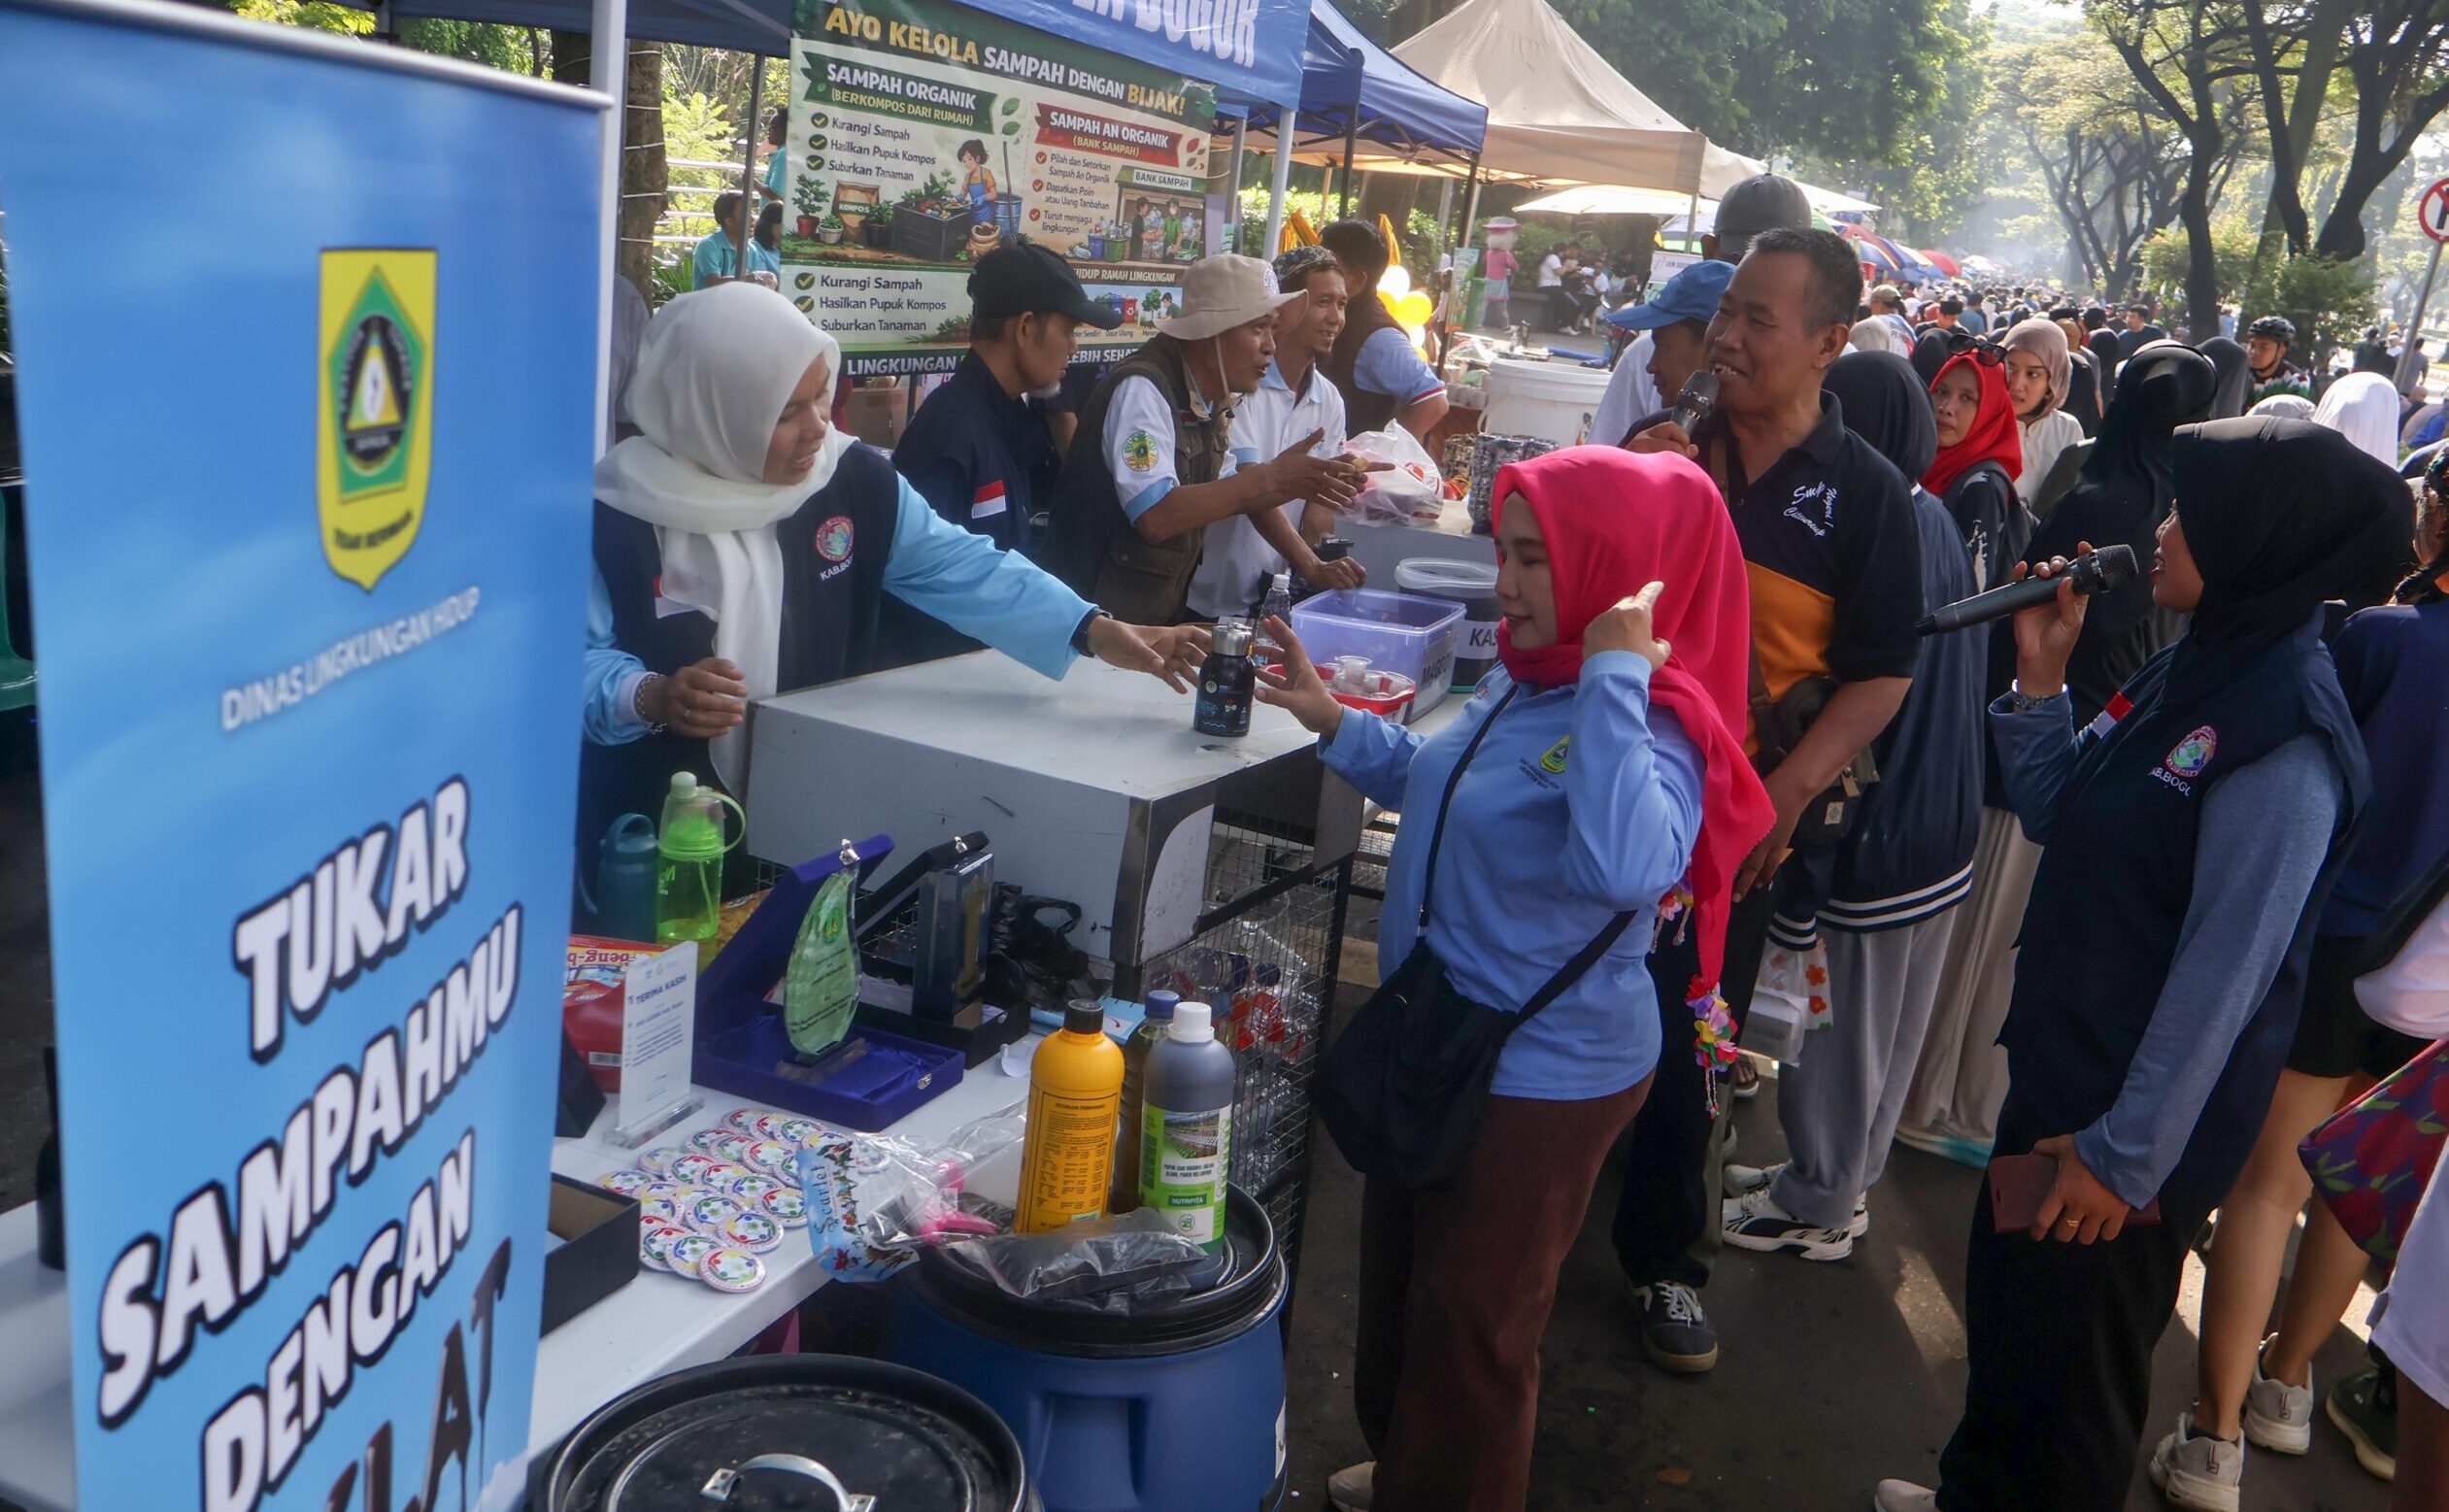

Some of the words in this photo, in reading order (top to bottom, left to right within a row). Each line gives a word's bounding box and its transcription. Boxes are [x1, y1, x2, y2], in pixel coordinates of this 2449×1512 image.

[825, 7, 881, 41] AYO
[889, 21, 979, 65] KELOLA
[984, 47, 1065, 84] SAMPAH
[1068, 69, 1124, 99] DENGAN
[1127, 84, 1187, 116] BIJAK!
[826, 63, 902, 95] SAMPAH
[906, 81, 977, 110] ORGANIK
[831, 87, 905, 114] (BERKOMPOS
[907, 104, 932, 118] DARI
[933, 109, 974, 127] RUMAH)
[831, 117, 871, 137] Kurangi
[873, 124, 910, 142] Sampah
[1050, 112, 1101, 136] SAMPAH
[1102, 122, 1119, 139] AN
[1121, 127, 1169, 149] ORGANIK
[830, 139, 870, 156] Hasilkan
[872, 147, 899, 161] Pupuk
[902, 151, 936, 166] Kompos
[1073, 135, 1101, 151] (BANK
[1102, 139, 1140, 157] SAMPAH)
[828, 160, 872, 177] Suburkan
[876, 166, 914, 182] Tanaman
[1050, 153, 1068, 165] Pilah
[1068, 157, 1082, 166] dan
[1082, 159, 1111, 172] Setorkan
[1049, 166, 1075, 179] Sampah
[1076, 170, 1085, 180] An
[1085, 173, 1110, 185] Organik
[1135, 172, 1156, 185] BANK
[1157, 174, 1190, 188] SAMPAH
[1046, 182, 1078, 195] Dapatkan
[1044, 210, 1062, 221] Turut
[821, 275, 870, 291] Kurangi
[874, 277, 923, 292] Sampah
[1101, 269, 1128, 281] RAMAH
[1129, 271, 1175, 283] LINGKUNGAN
[820, 296, 866, 310] Hasilkan
[870, 298, 903, 313] Pupuk
[906, 299, 947, 313] Kompos
[821, 319, 875, 332] Suburkan
[878, 319, 926, 332] Tanaman
[847, 355, 956, 376] LINGKUNGAN
[221, 663, 304, 730] DINAS
[304, 610, 435, 695] LINGKUNGAN
[434, 586, 481, 636] HIDUP
[234, 775, 470, 1062] TUKAR
[98, 901, 522, 1428] SAMPAHMU
[200, 1128, 476, 1512] DENGAN
[323, 1236, 513, 1512] LAT
